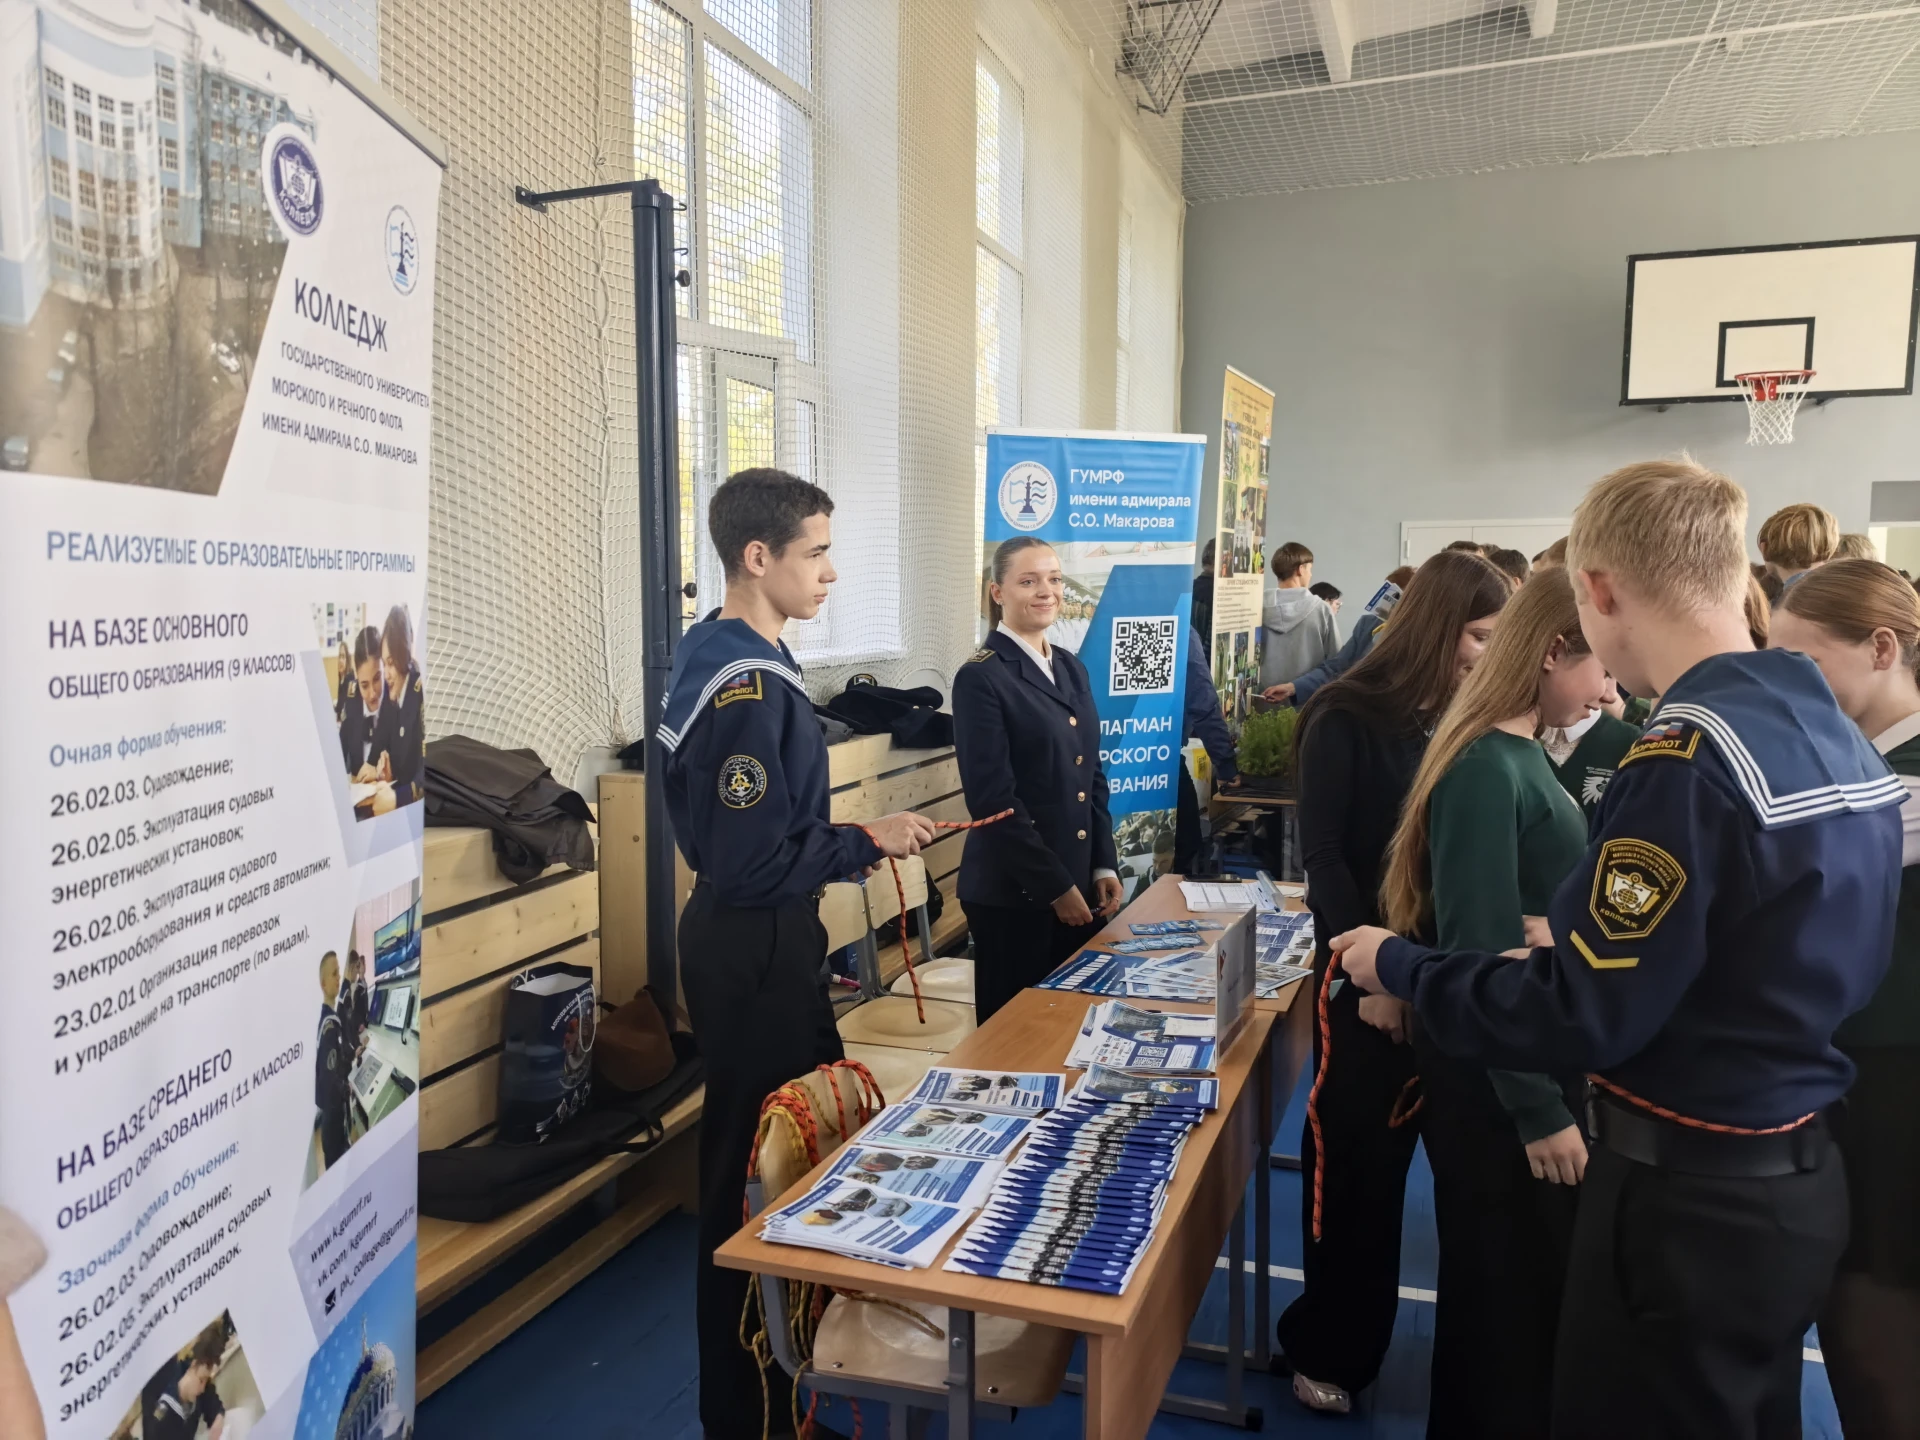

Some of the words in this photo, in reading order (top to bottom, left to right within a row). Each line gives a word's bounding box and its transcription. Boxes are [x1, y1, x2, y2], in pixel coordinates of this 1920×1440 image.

[295, 277, 388, 352] КОЛЛЕДЖ
[281, 341, 374, 389] ГОСУДАРСТВЕННОГО
[272, 376, 326, 408] МОРСКОГО
[329, 395, 336, 411] И
[338, 398, 377, 423] РЕЧНОГО
[379, 411, 403, 431] ФЛОТА
[262, 412, 301, 437] ИМЕНИ
[304, 423, 352, 451] АДМИРАЛА
[354, 436, 372, 455] С.О.
[375, 441, 418, 465] МАКАРОВА
[1069, 494, 1117, 506] имени
[1121, 496, 1191, 510] адмирала
[1070, 469, 1125, 484] ГУМРФ
[1068, 513, 1100, 527] С.О.
[1104, 513, 1175, 531] Макарова
[47, 531, 197, 565] РЕАЛИЗУЕМЫЕ
[203, 541, 343, 571] ОБРАЗОВАТЕЛЬНЫЕ
[345, 549, 416, 573] ПРОГРАММЫ
[49, 619, 86, 649] НА
[95, 617, 148, 646] БАЗЕ
[153, 613, 248, 642] ОСНОВНОГО
[49, 670, 129, 699] ОБЩЕГО
[133, 660, 224, 690] ОБРАЗОВАНИЯ
[228, 658, 241, 682] (9
[243, 653, 296, 677] КЛАССОВ)
[720, 687, 754, 700] МОРФЛОТ
[50, 741, 112, 767] Очная
[118, 730, 162, 760] форма
[164, 719, 227, 748] обучения:
[1100, 716, 1172, 736] ЛАГМАН
[1099, 744, 1170, 765] РСКОГО
[50, 779, 139, 818] 26.02.03.
[143, 758, 234, 799] Судовождение;
[51, 824, 139, 866] 26.02.05.
[143, 800, 224, 841] Эксплуатация
[229, 786, 274, 813] судовых
[52, 848, 170, 905] энергетических
[173, 826, 244, 864] установок;
[52, 905, 140, 953] 26.02.06.
[143, 869, 225, 920] Эксплуатация
[229, 851, 277, 884] судового
[53, 905, 211, 990] электрооборудования
[216, 899, 224, 916] и
[228, 883, 270, 913] средств
[273, 856, 331, 892] автоматики;
[1600, 908, 1639, 929] КОЛЛЕДЖ
[54, 985, 136, 1039] 23.02.01
[139, 944, 217, 1000] Организация
[222, 914, 280, 954] перевозок
[54, 1056, 68, 1075] и
[75, 1006, 158, 1072] управление
[160, 995, 173, 1015] на
[177, 959, 250, 1007] транспорте
[253, 946, 270, 971] (по
[273, 925, 310, 957] видам).
[57, 1144, 96, 1183] НА
[103, 1105, 146, 1160] БАЗЕ
[149, 1048, 232, 1121] СРЕДНЕГО
[57, 1167, 133, 1230] ОБЩЕГО
[136, 1093, 228, 1177] ОБРАЗОВАНИЯ
[231, 1079, 250, 1108] (11
[253, 1041, 304, 1089] КЛАССОВ)
[57, 1230, 132, 1294] Заочная
[135, 1190, 169, 1237] форма
[173, 1141, 239, 1197] обучения:
[228, 1185, 272, 1234] судовых
[172, 1242, 242, 1314] установок.
